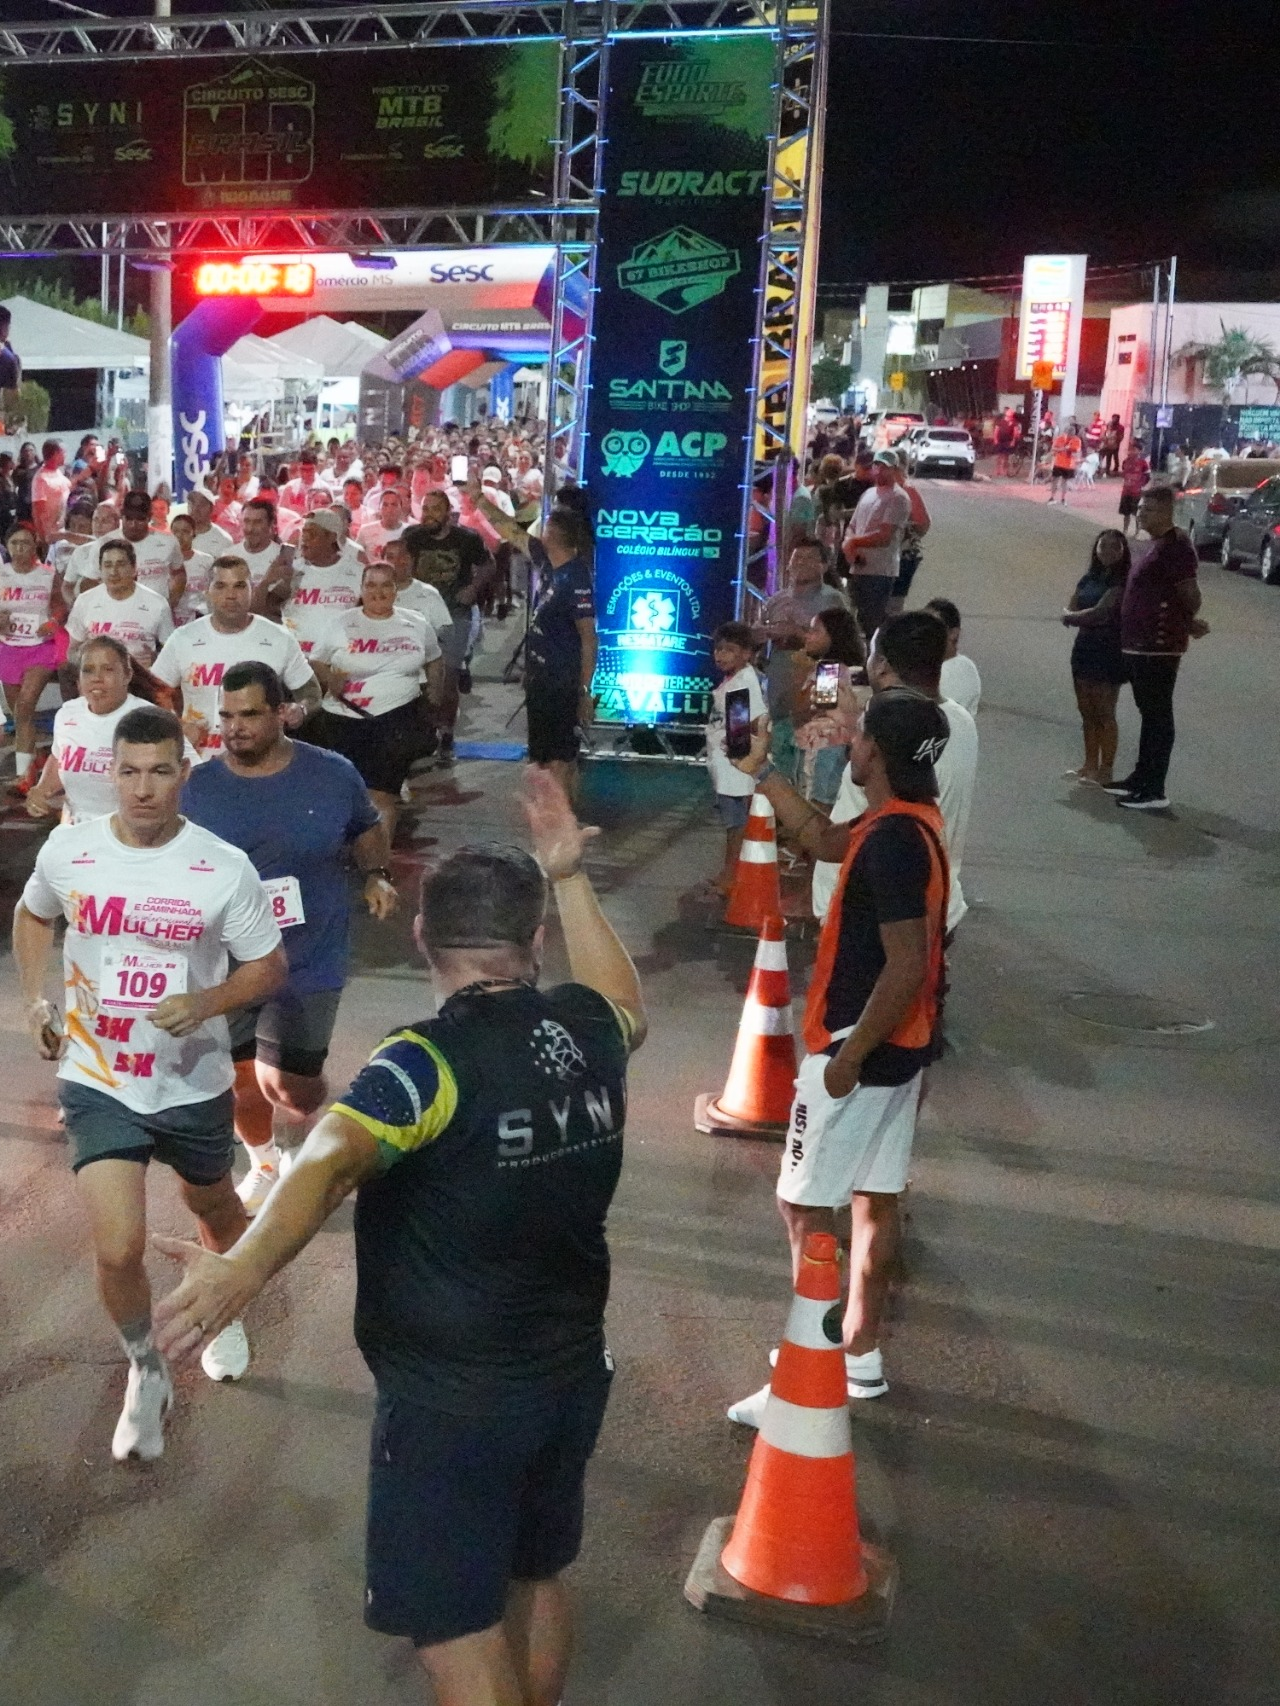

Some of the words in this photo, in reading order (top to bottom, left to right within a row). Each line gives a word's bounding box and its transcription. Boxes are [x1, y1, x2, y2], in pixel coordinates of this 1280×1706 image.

[191, 87, 263, 101] CIRCUITO
[268, 86, 308, 98] SESC
[379, 95, 442, 115] MTB
[616, 170, 767, 196] SUDRACT
[429, 263, 495, 283] Sesc
[626, 269, 644, 281] 67
[648, 256, 731, 279] BIKESHOP
[315, 274, 369, 287] omércio
[372, 273, 394, 286] MS
[451, 321, 499, 331] CIRCUITO
[609, 378, 733, 400] SANTANA
[654, 430, 728, 458] ACP
[660, 470, 690, 478] DESDE
[616, 543, 656, 556] COLÉGIO
[656, 545, 701, 557] BILÍNGUE
[606, 571, 644, 615] REMOÇÕES
[644, 568, 653, 579] &
[654, 568, 694, 597] EVENTOS
[688, 596, 701, 620] LTDA
[9, 623, 32, 636] 042
[61, 745, 113, 774] MULH
[133, 903, 143, 911] E
[142, 904, 203, 918] CAMINHADA
[146, 896, 192, 908] CORRIDA
[77, 894, 205, 942] MULHER
[117, 970, 168, 999] 109
